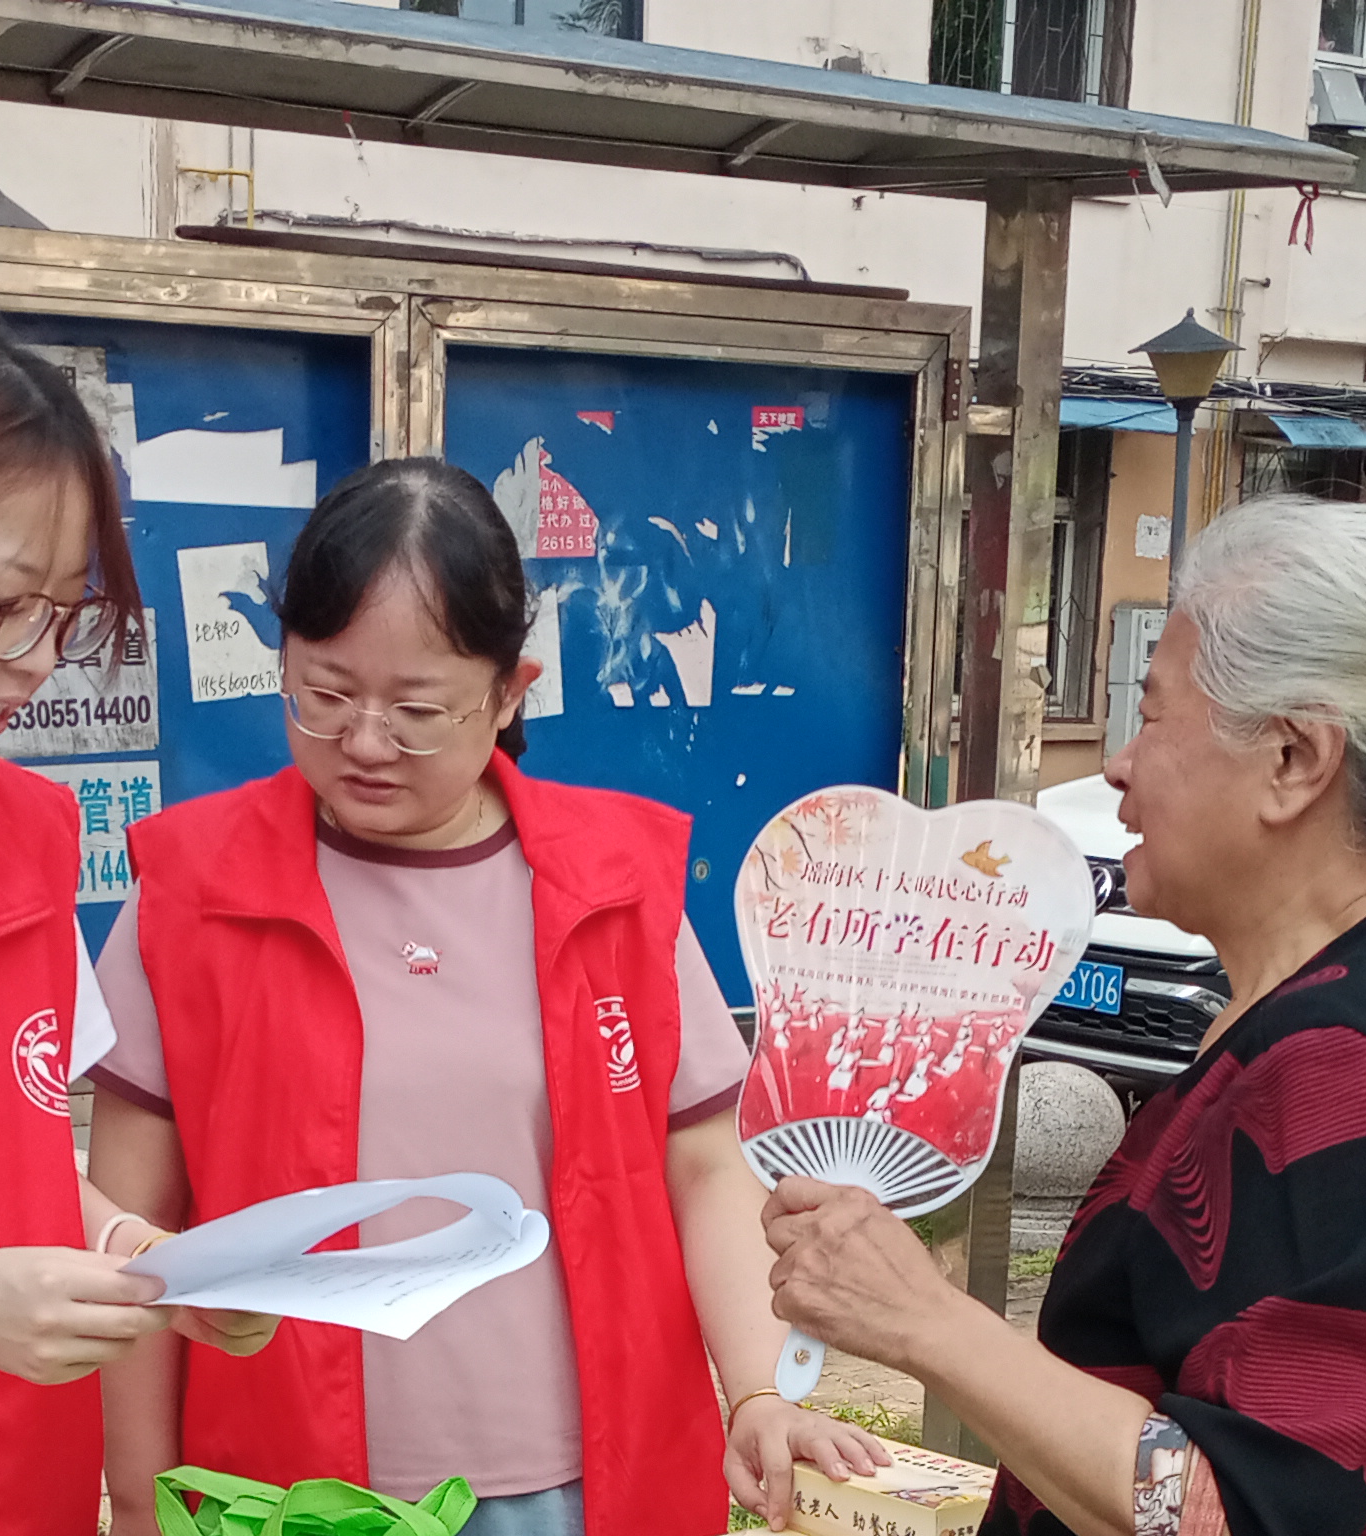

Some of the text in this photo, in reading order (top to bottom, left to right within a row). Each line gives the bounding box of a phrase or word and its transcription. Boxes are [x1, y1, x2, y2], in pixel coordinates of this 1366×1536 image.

[541, 535, 575, 550] 2615
[195, 620, 240, 643] 地铁口
[800, 861, 1029, 909] 瑶海区十大暖民心行动
[766, 895, 1057, 972] 老有所学在行动
